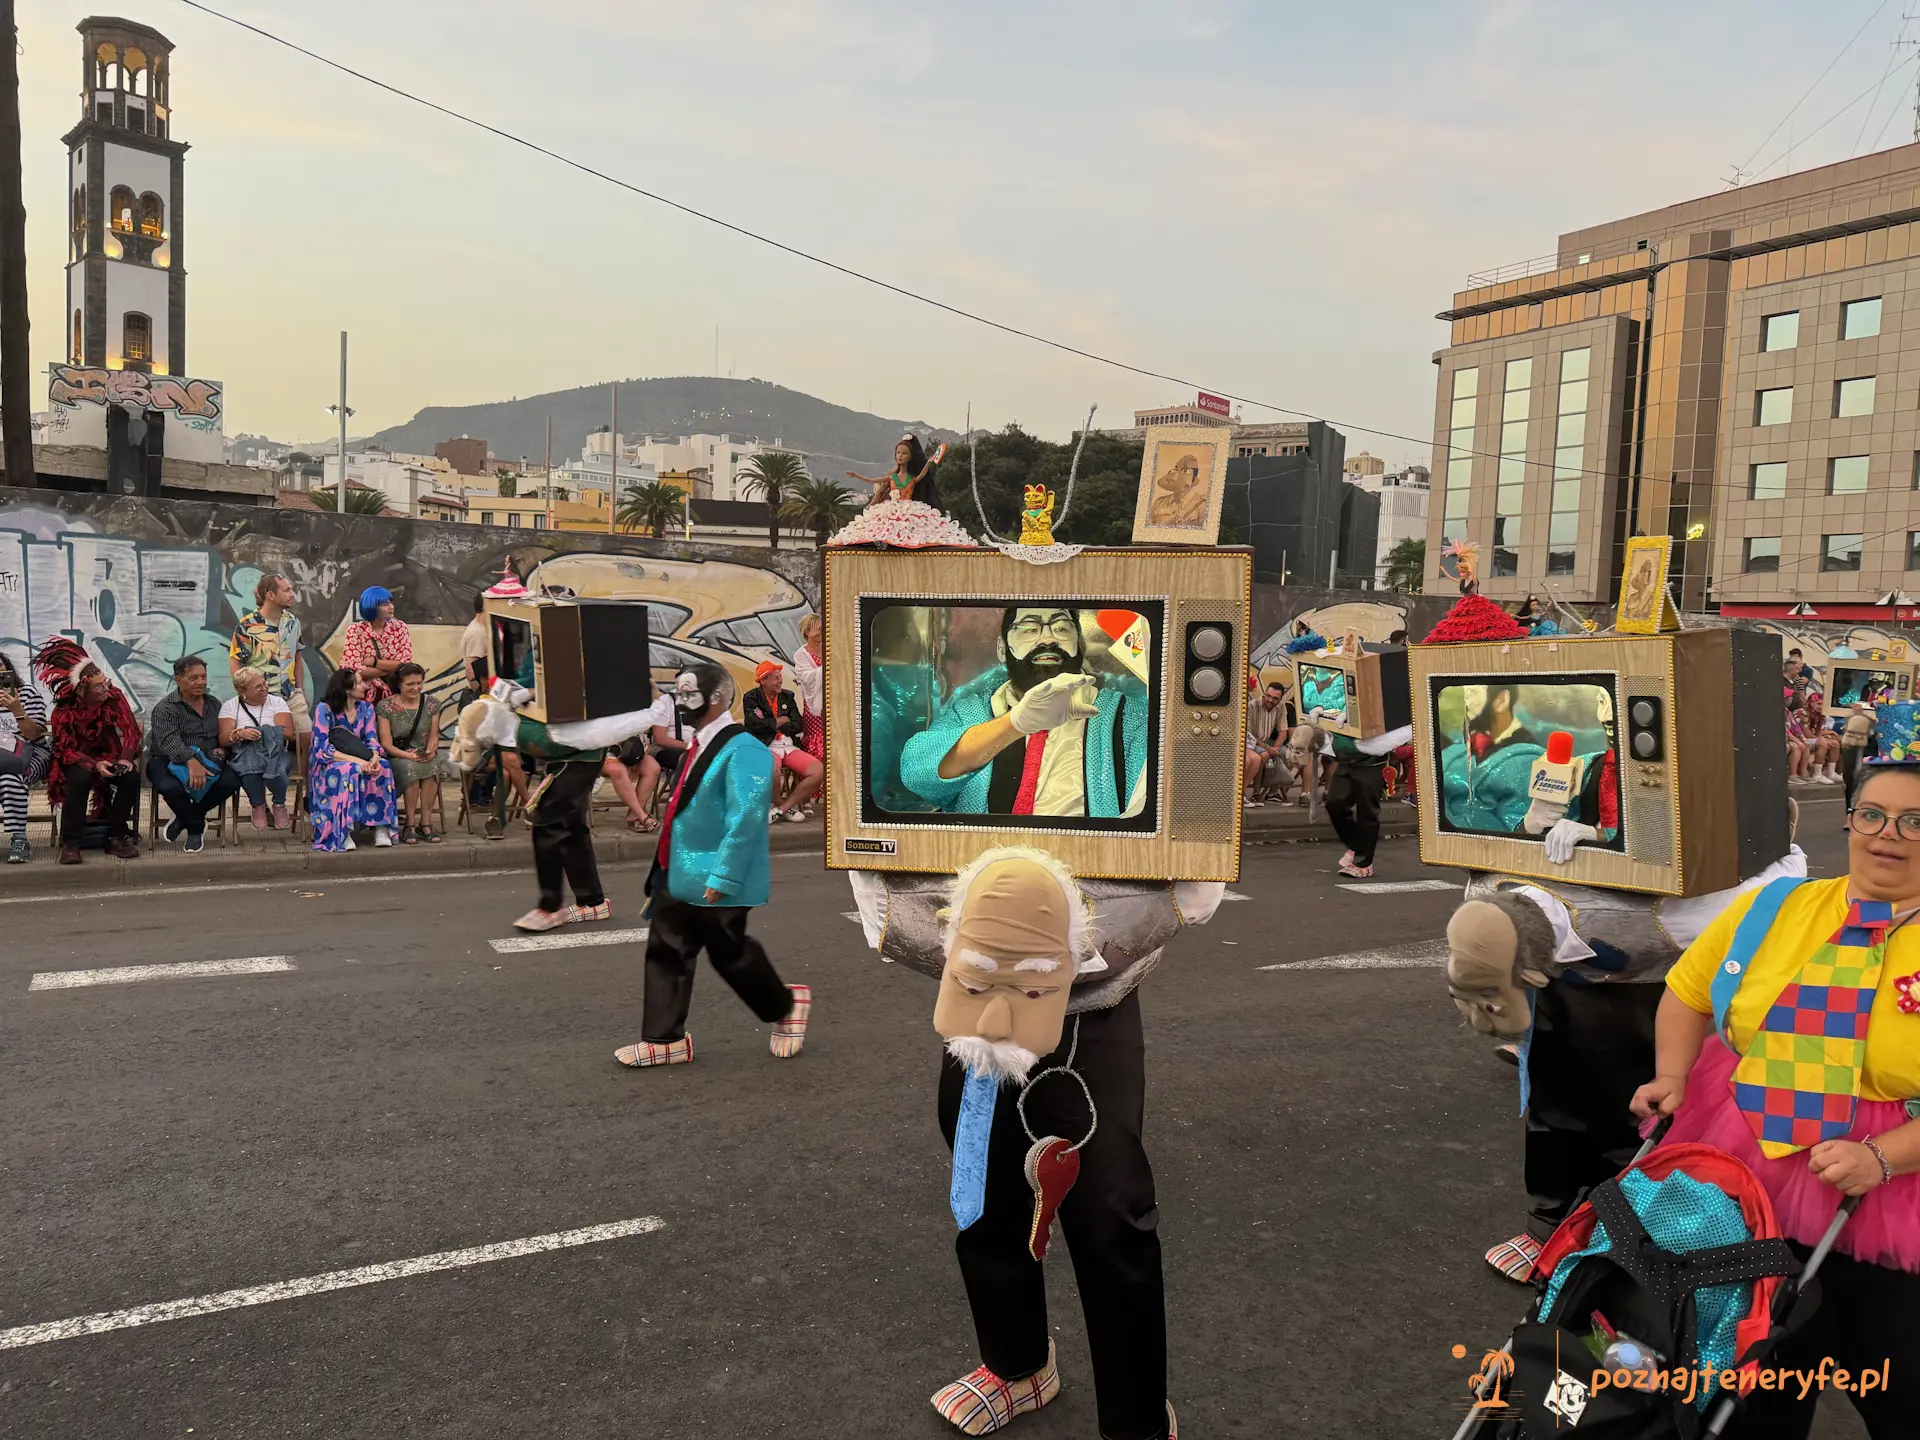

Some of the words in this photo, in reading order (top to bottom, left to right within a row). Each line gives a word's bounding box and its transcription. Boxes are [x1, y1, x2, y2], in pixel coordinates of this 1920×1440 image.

[1206, 398, 1229, 413] Santander
[191, 420, 215, 434] 2017
[847, 840, 880, 850] Sonora
[881, 841, 895, 852] TV
